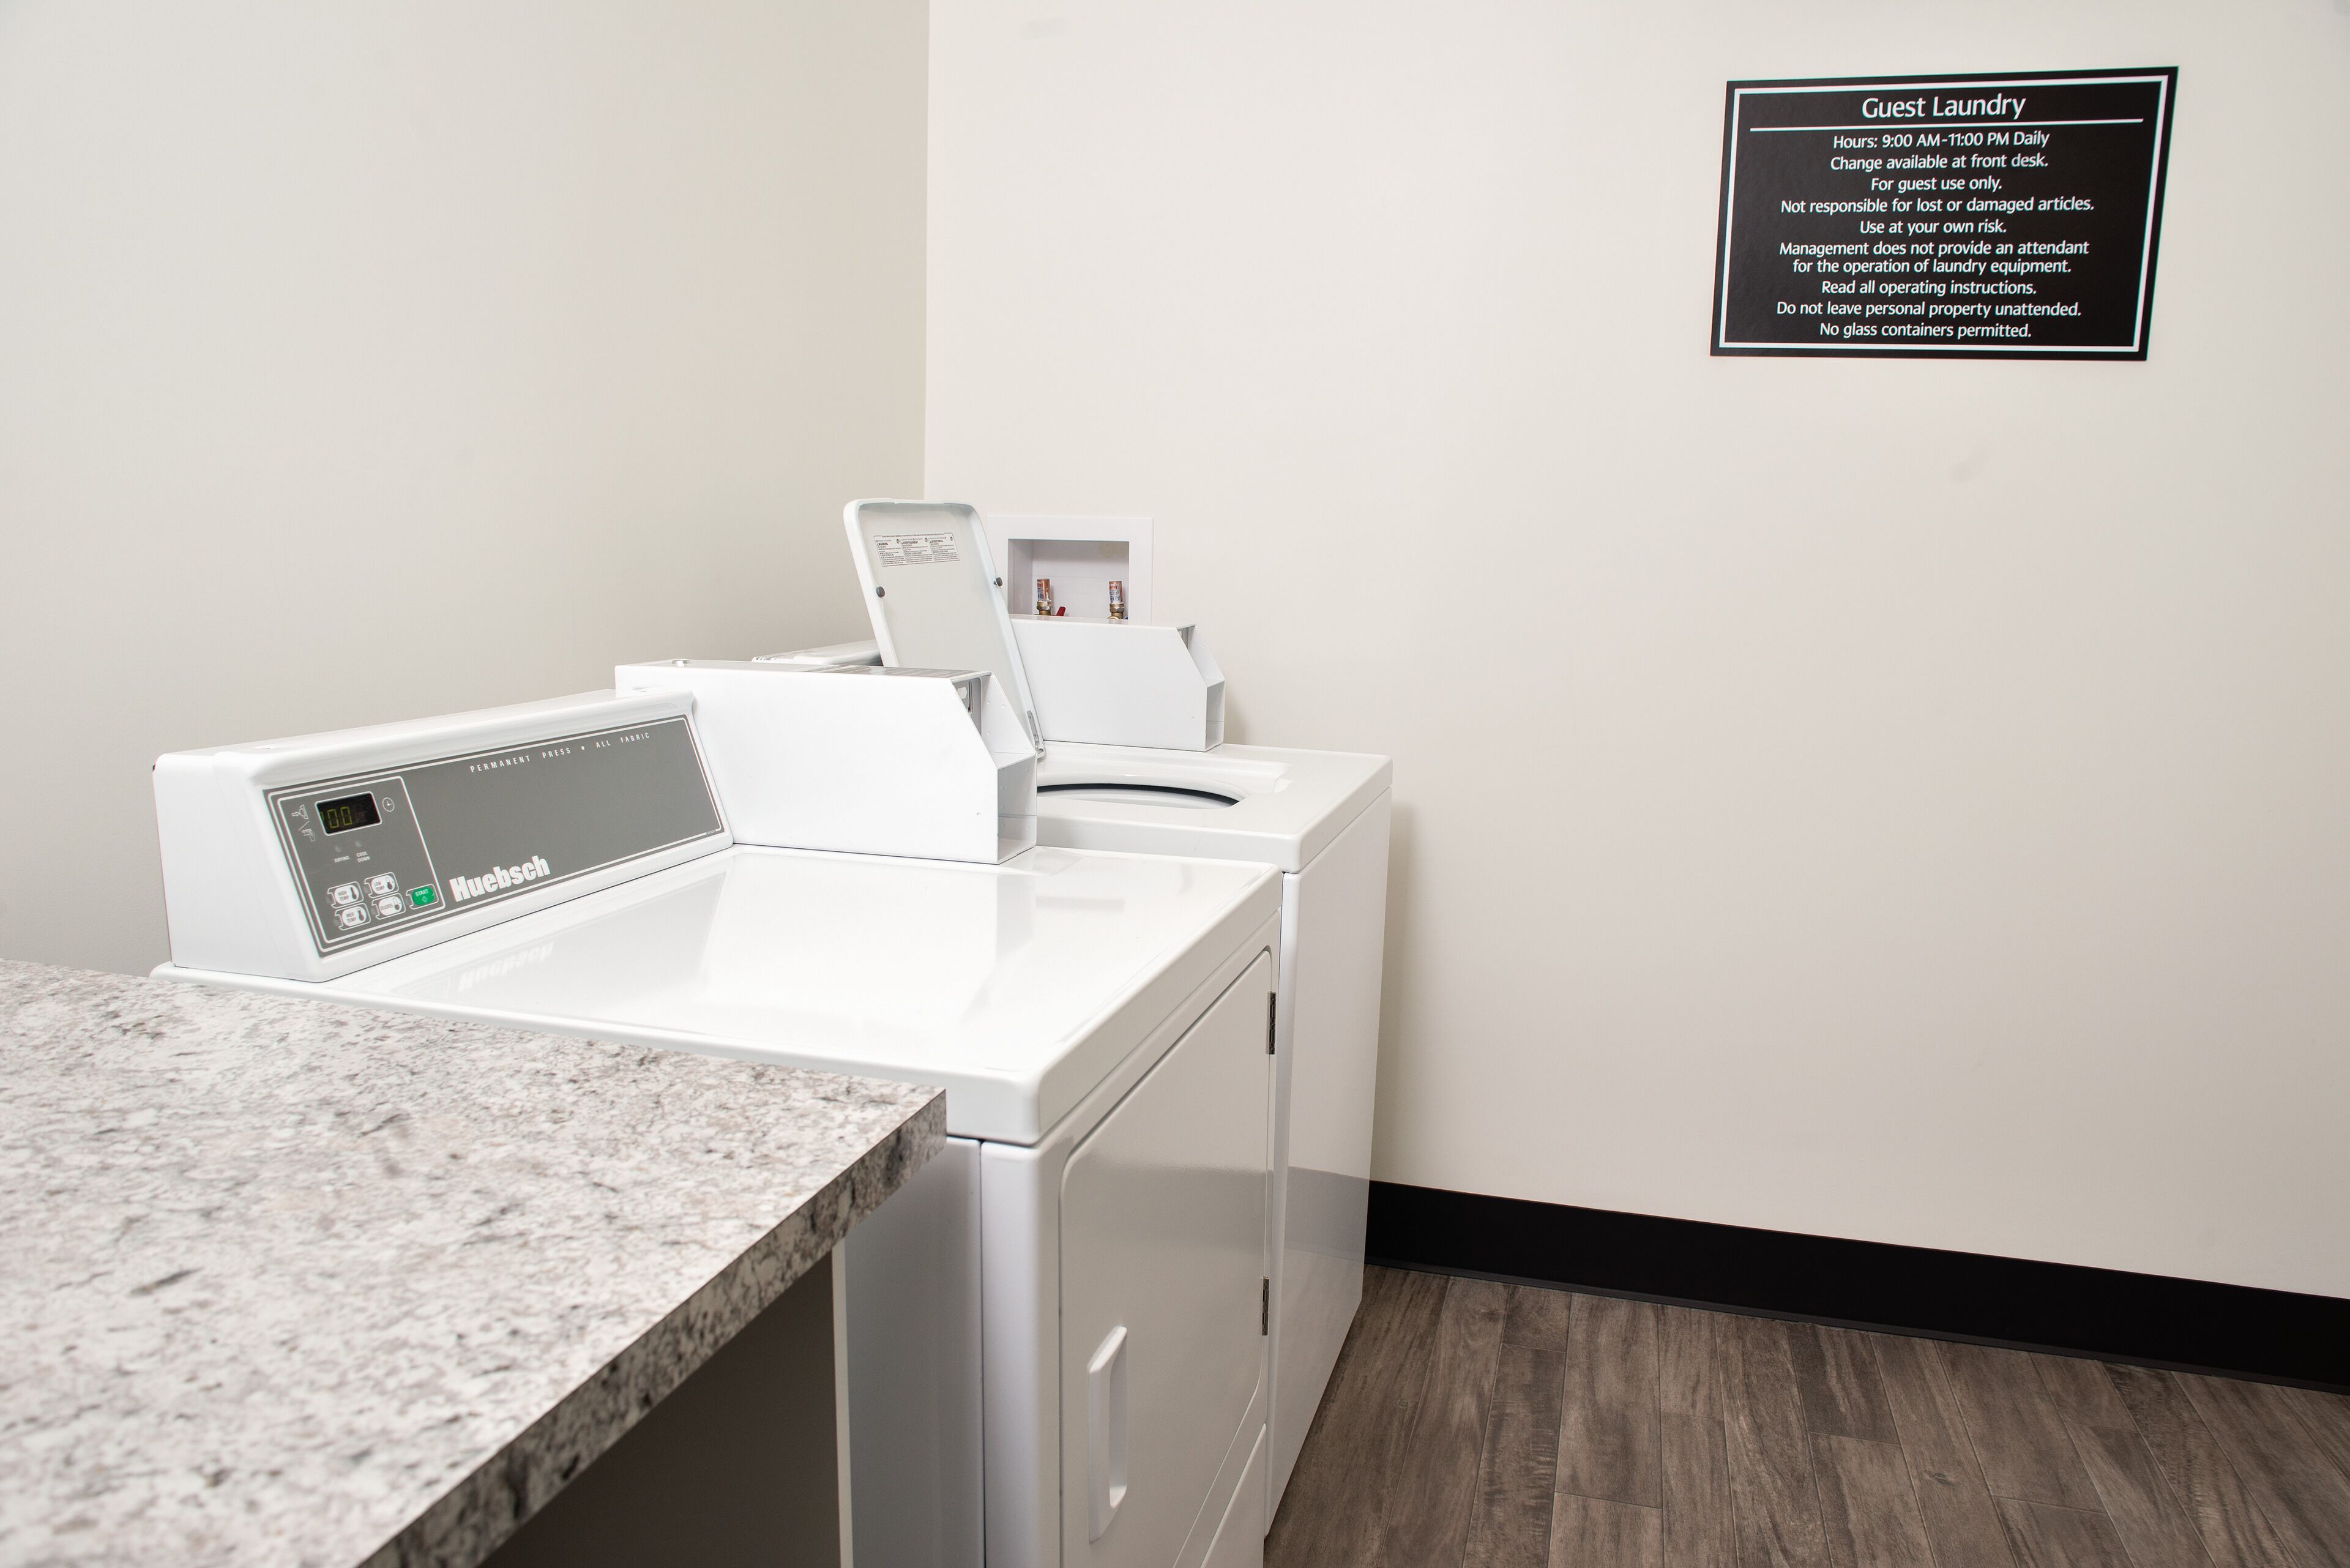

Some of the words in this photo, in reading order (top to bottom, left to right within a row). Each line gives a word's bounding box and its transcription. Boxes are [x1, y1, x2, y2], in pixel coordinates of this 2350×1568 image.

[1862, 97, 1927, 119] Guest
[1933, 92, 2026, 120] Laundry
[1833, 135, 1878, 149] Hours:
[1882, 133, 1913, 148] 9:00
[1987, 132, 2009, 146] PM
[2013, 130, 2050, 148] Daily
[1830, 155, 1882, 173] Change
[1886, 154, 1948, 170] available
[1952, 155, 1967, 168] at
[1971, 153, 2007, 168] front
[2011, 152, 2048, 167] desk.
[1871, 177, 1895, 191] For
[1898, 177, 1938, 193] guest
[1941, 179, 1966, 190] use
[1969, 175, 2002, 193] only.
[1781, 200, 1807, 213] Not
[1810, 198, 1888, 216] responsible
[1891, 198, 1913, 212] for
[1917, 197, 1943, 212] lost
[1946, 200, 1963, 212] or
[1966, 196, 2034, 214] damaged
[2038, 196, 2094, 211] articles.
[1860, 220, 1885, 234] Use
[1889, 220, 1904, 234] at
[1907, 222, 1940, 236] your
[1943, 222, 1974, 233] own
[1978, 218, 2007, 233] risk.
[1779, 242, 1870, 258] Management
[1873, 241, 1906, 255] does
[1911, 242, 1935, 255] not
[1938, 240, 1992, 258] provide
[1995, 244, 2013, 255] an
[2017, 240, 2090, 255] attendant
[1792, 258, 1813, 273] for
[1816, 258, 1840, 273] the
[1843, 258, 1910, 276] operation
[1914, 258, 1930, 273] of
[1933, 258, 1987, 275] laundry
[1990, 258, 2072, 276] equipment.
[1822, 280, 1856, 294] Read
[1859, 280, 1876, 294] all
[1879, 280, 1946, 297] operating
[1950, 280, 2037, 294] instructions.
[1777, 301, 1796, 315] Do
[1800, 302, 1824, 315] not
[1827, 301, 1862, 315] leave
[1865, 301, 1925, 318] personal
[1929, 303, 1992, 319] property
[1995, 302, 2081, 316] unattended.
[1820, 323, 1840, 336] No
[1843, 322, 1878, 338] glass
[1881, 322, 1954, 337] containers
[1957, 323, 2032, 340] permitted.
[469, 755, 531, 773] PERMANENT
[542, 747, 572, 759] PRESS
[595, 739, 611, 749] ALL
[620, 732, 651, 744] FABRIC
[449, 855, 551, 902] Huebsch
[415, 889, 429, 897] START
